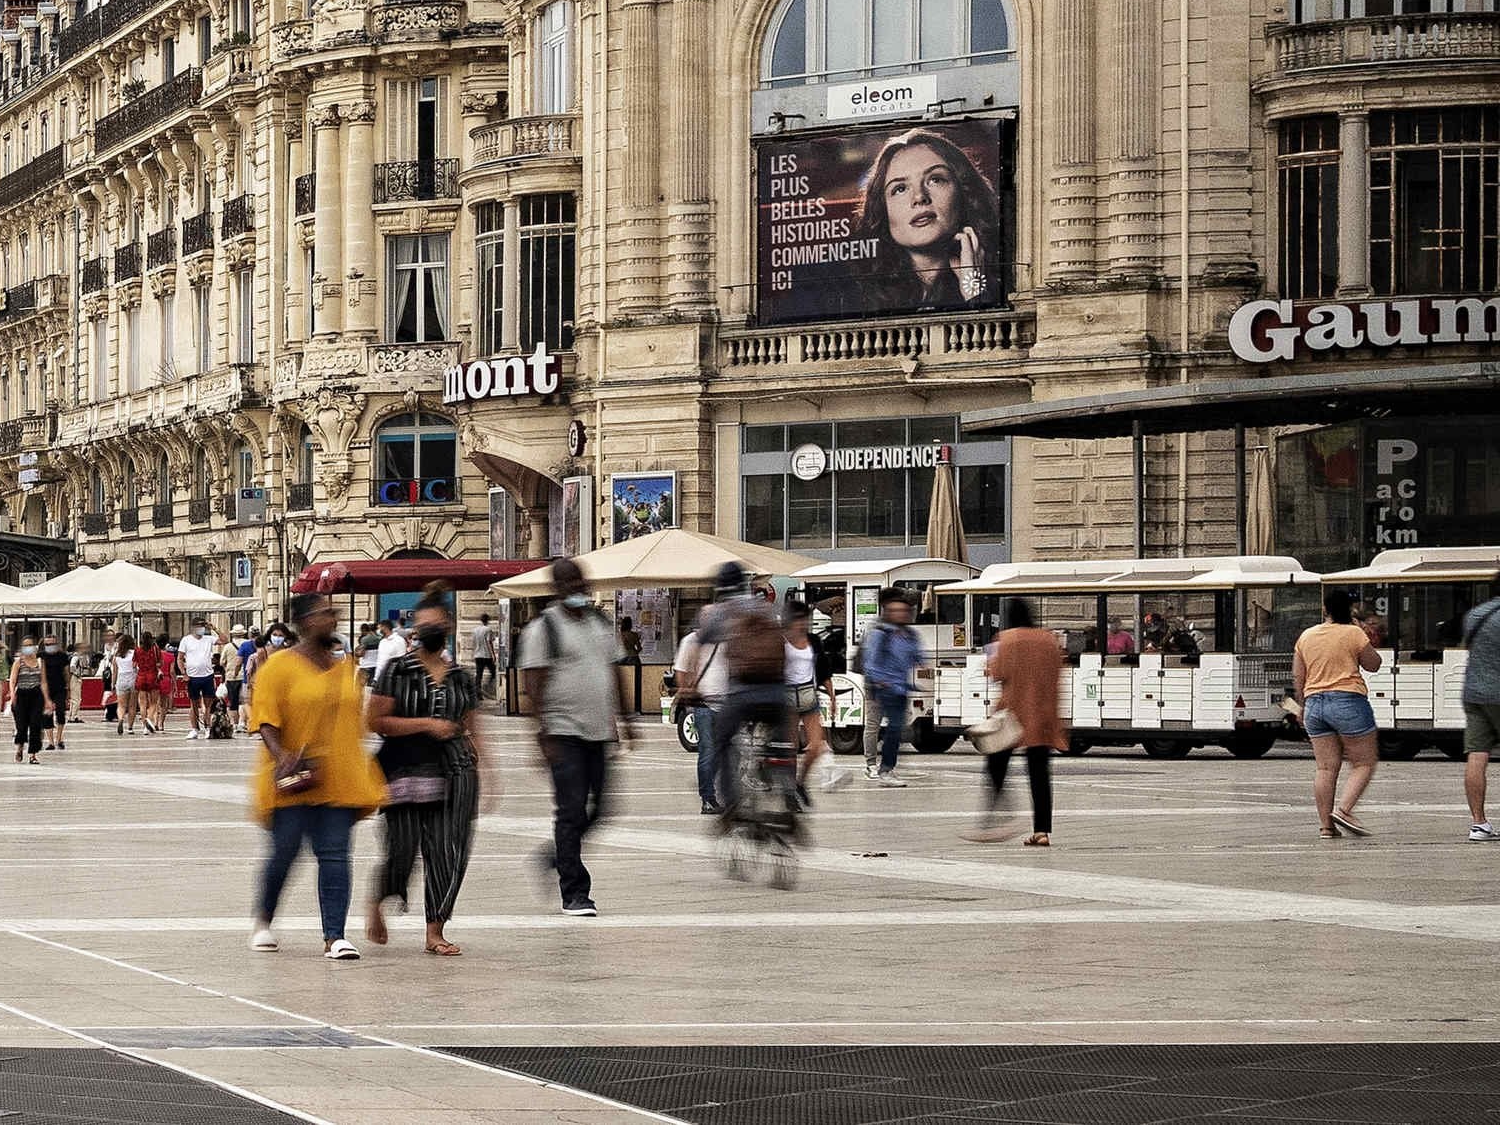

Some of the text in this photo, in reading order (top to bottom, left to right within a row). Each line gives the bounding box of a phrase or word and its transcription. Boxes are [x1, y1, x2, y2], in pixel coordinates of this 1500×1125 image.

[851, 86, 913, 105] eleom
[851, 102, 912, 114] avocats
[771, 154, 797, 175] LES
[771, 176, 810, 198] PLUS
[771, 197, 826, 221] BELLES
[771, 218, 850, 244] HISTOIRES
[771, 238, 879, 267] COMMENCENT
[771, 270, 792, 291] ICI
[1228, 299, 1500, 363] Gaum
[443, 342, 558, 404] mont
[827, 446, 941, 471] INDEPENDENCE
[380, 479, 447, 505] CIC
